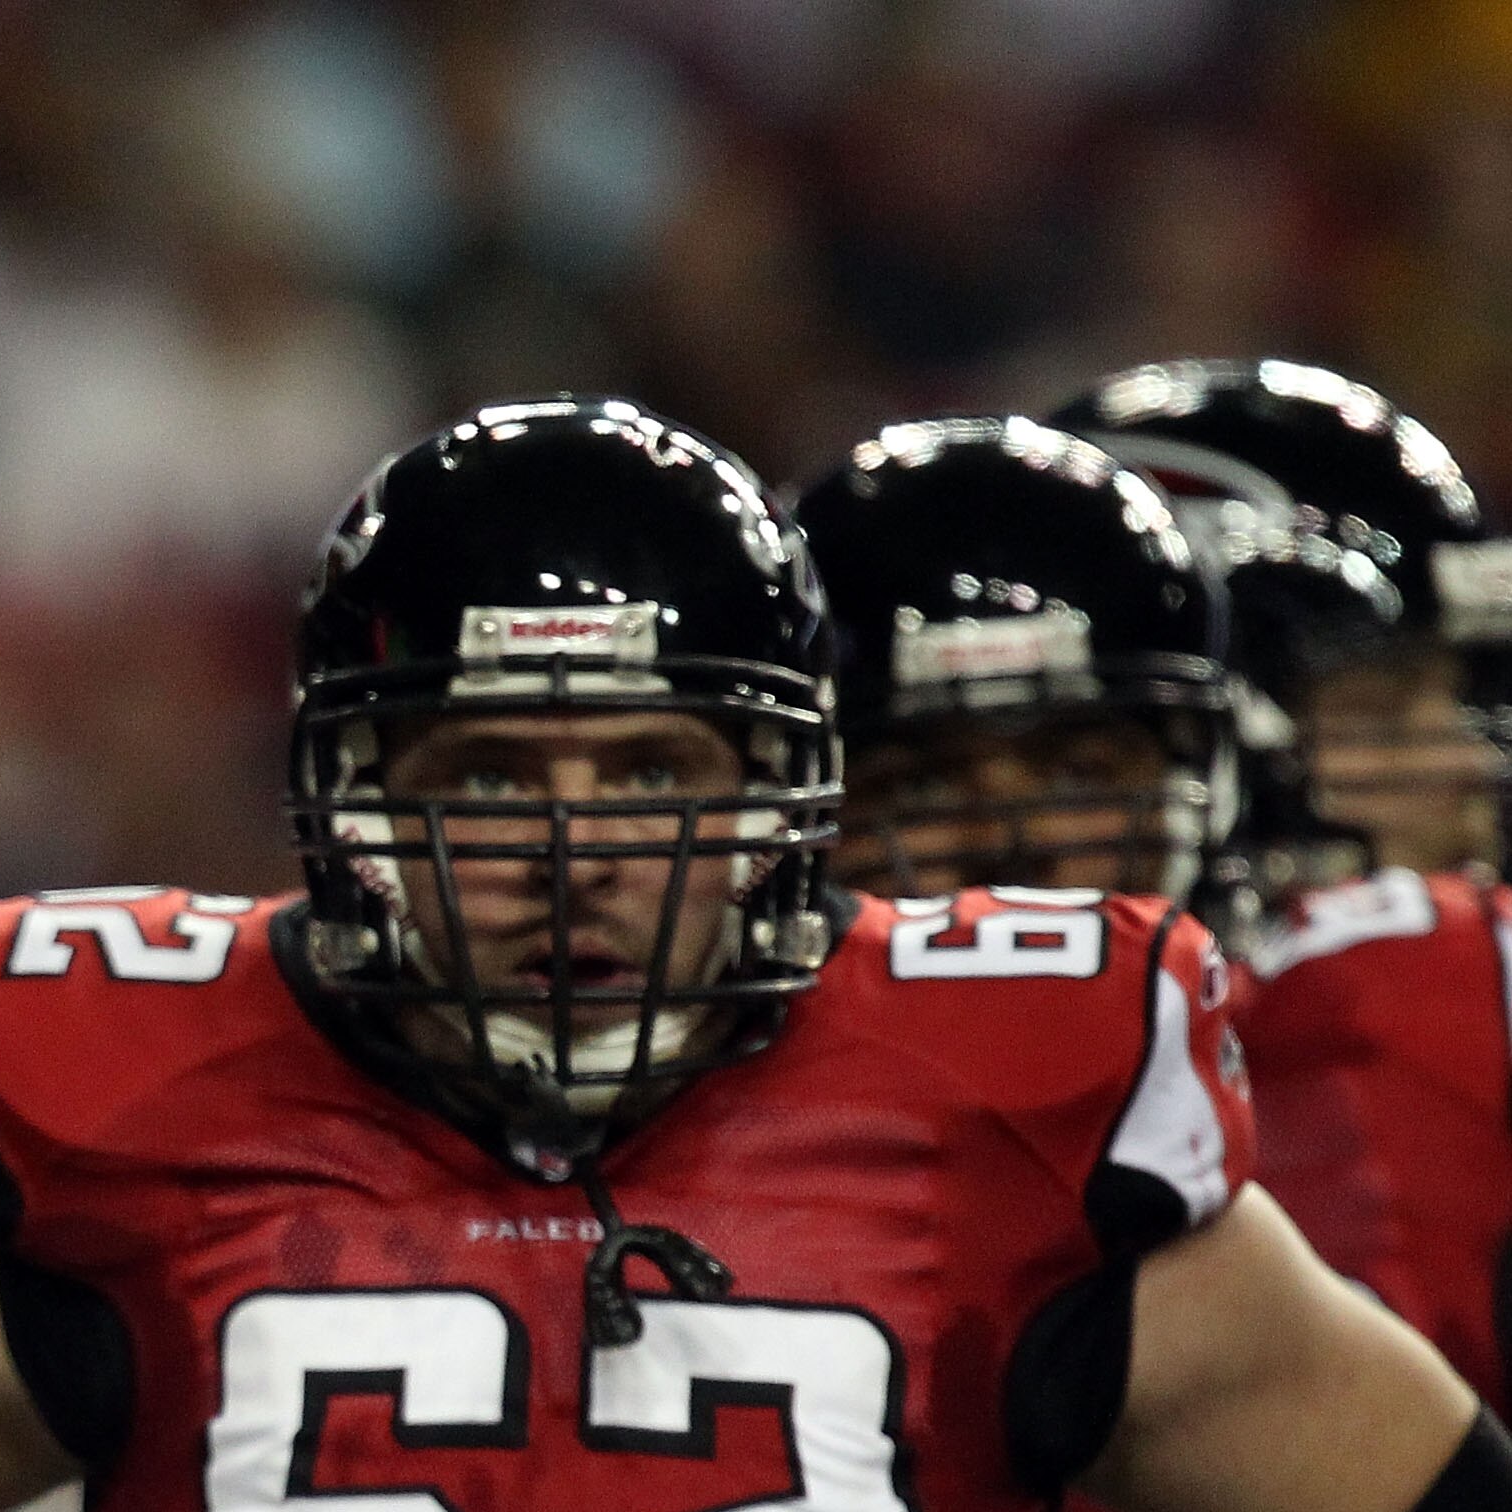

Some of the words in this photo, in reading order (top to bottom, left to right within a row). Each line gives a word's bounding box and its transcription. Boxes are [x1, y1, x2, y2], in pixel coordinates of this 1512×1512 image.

[4, 885, 255, 980] 2
[891, 885, 1105, 979] 6
[466, 1216, 606, 1242] FALCO
